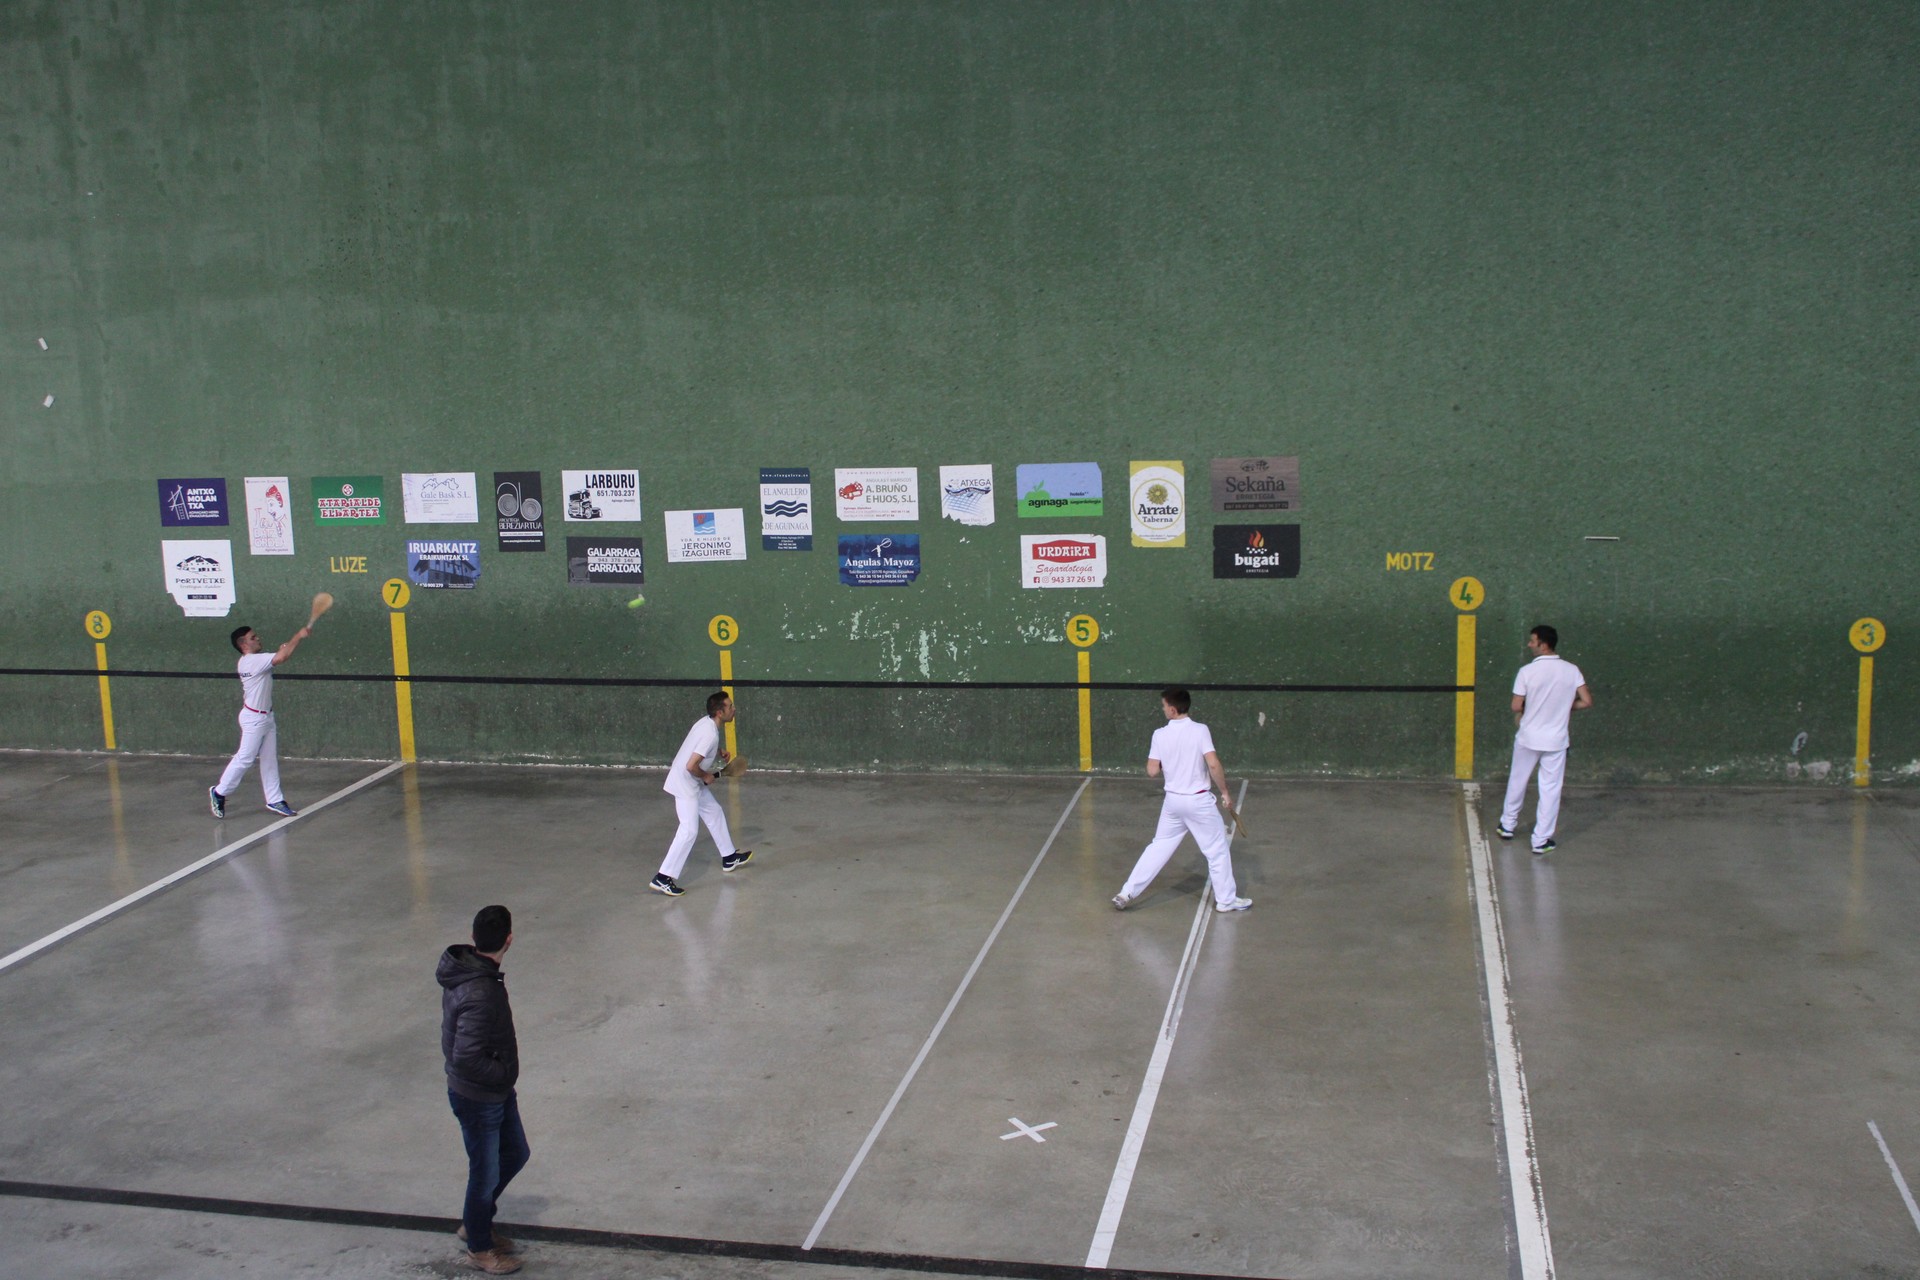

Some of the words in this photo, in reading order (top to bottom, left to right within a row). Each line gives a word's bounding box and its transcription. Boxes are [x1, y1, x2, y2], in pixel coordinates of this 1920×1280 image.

[585, 474, 635, 489] LARBURU
[876, 483, 907, 492] BRUÑO
[1226, 476, 1285, 492] Sekaña
[873, 495, 899, 504] HIJOS,
[1028, 499, 1068, 508] aginaga
[1138, 504, 1178, 515] Arrate
[409, 543, 477, 553] IRUARKAITZ
[587, 548, 641, 556] GALARRAGA
[682, 549, 731, 557] IZAGUIRRE
[330, 557, 368, 573] LUZE
[845, 558, 881, 568] Angulas
[884, 558, 914, 568] Mayoz
[1235, 552, 1279, 568] bugati
[1386, 552, 1434, 571] MOTZ
[588, 564, 642, 572] GARRAIOAK
[1036, 564, 1092, 574] Sagardotegia
[390, 584, 401, 604] 7
[1460, 582, 1473, 604] 4
[93, 614, 103, 634] 8
[717, 620, 730, 640] 6
[1076, 620, 1090, 641] 5
[1860, 624, 1875, 646] 3
